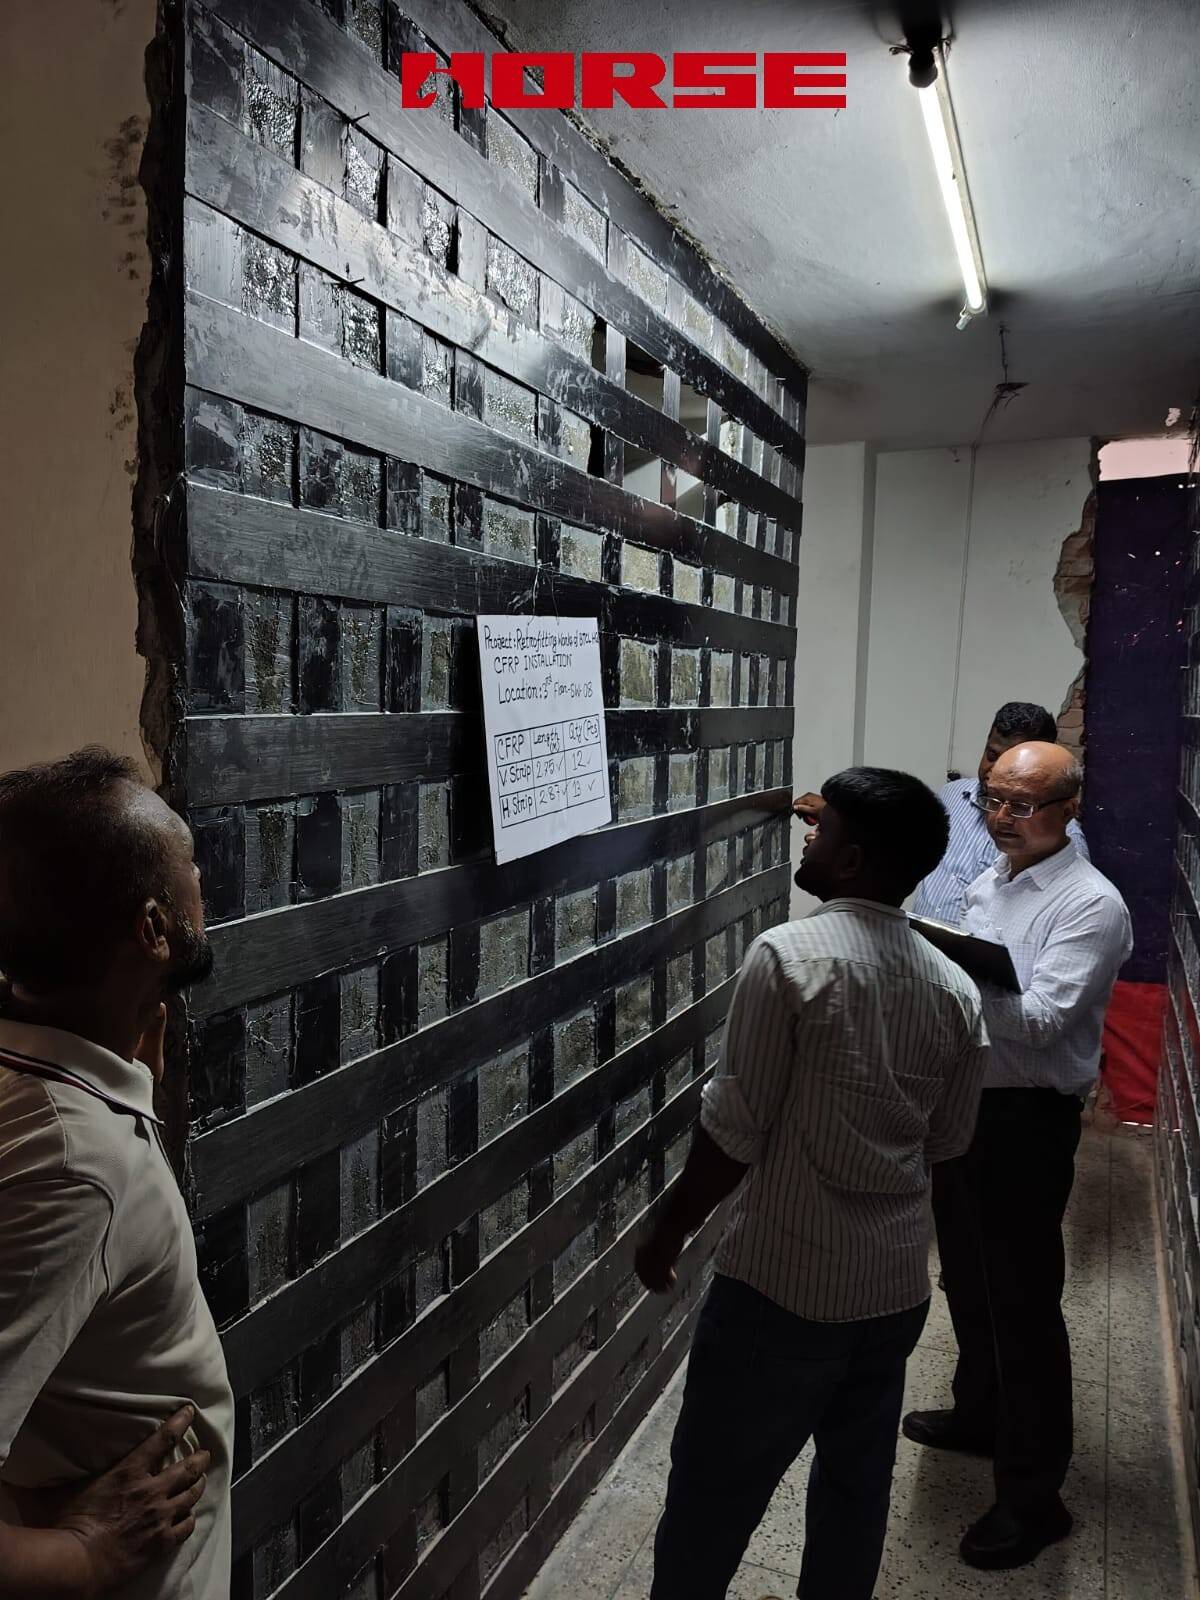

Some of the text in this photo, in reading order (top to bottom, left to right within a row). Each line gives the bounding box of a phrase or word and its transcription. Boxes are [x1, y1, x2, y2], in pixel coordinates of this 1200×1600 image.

[494, 656, 519, 674] CFRP
[497, 734, 524, 760] CFRP
[533, 727, 560, 747] Length
